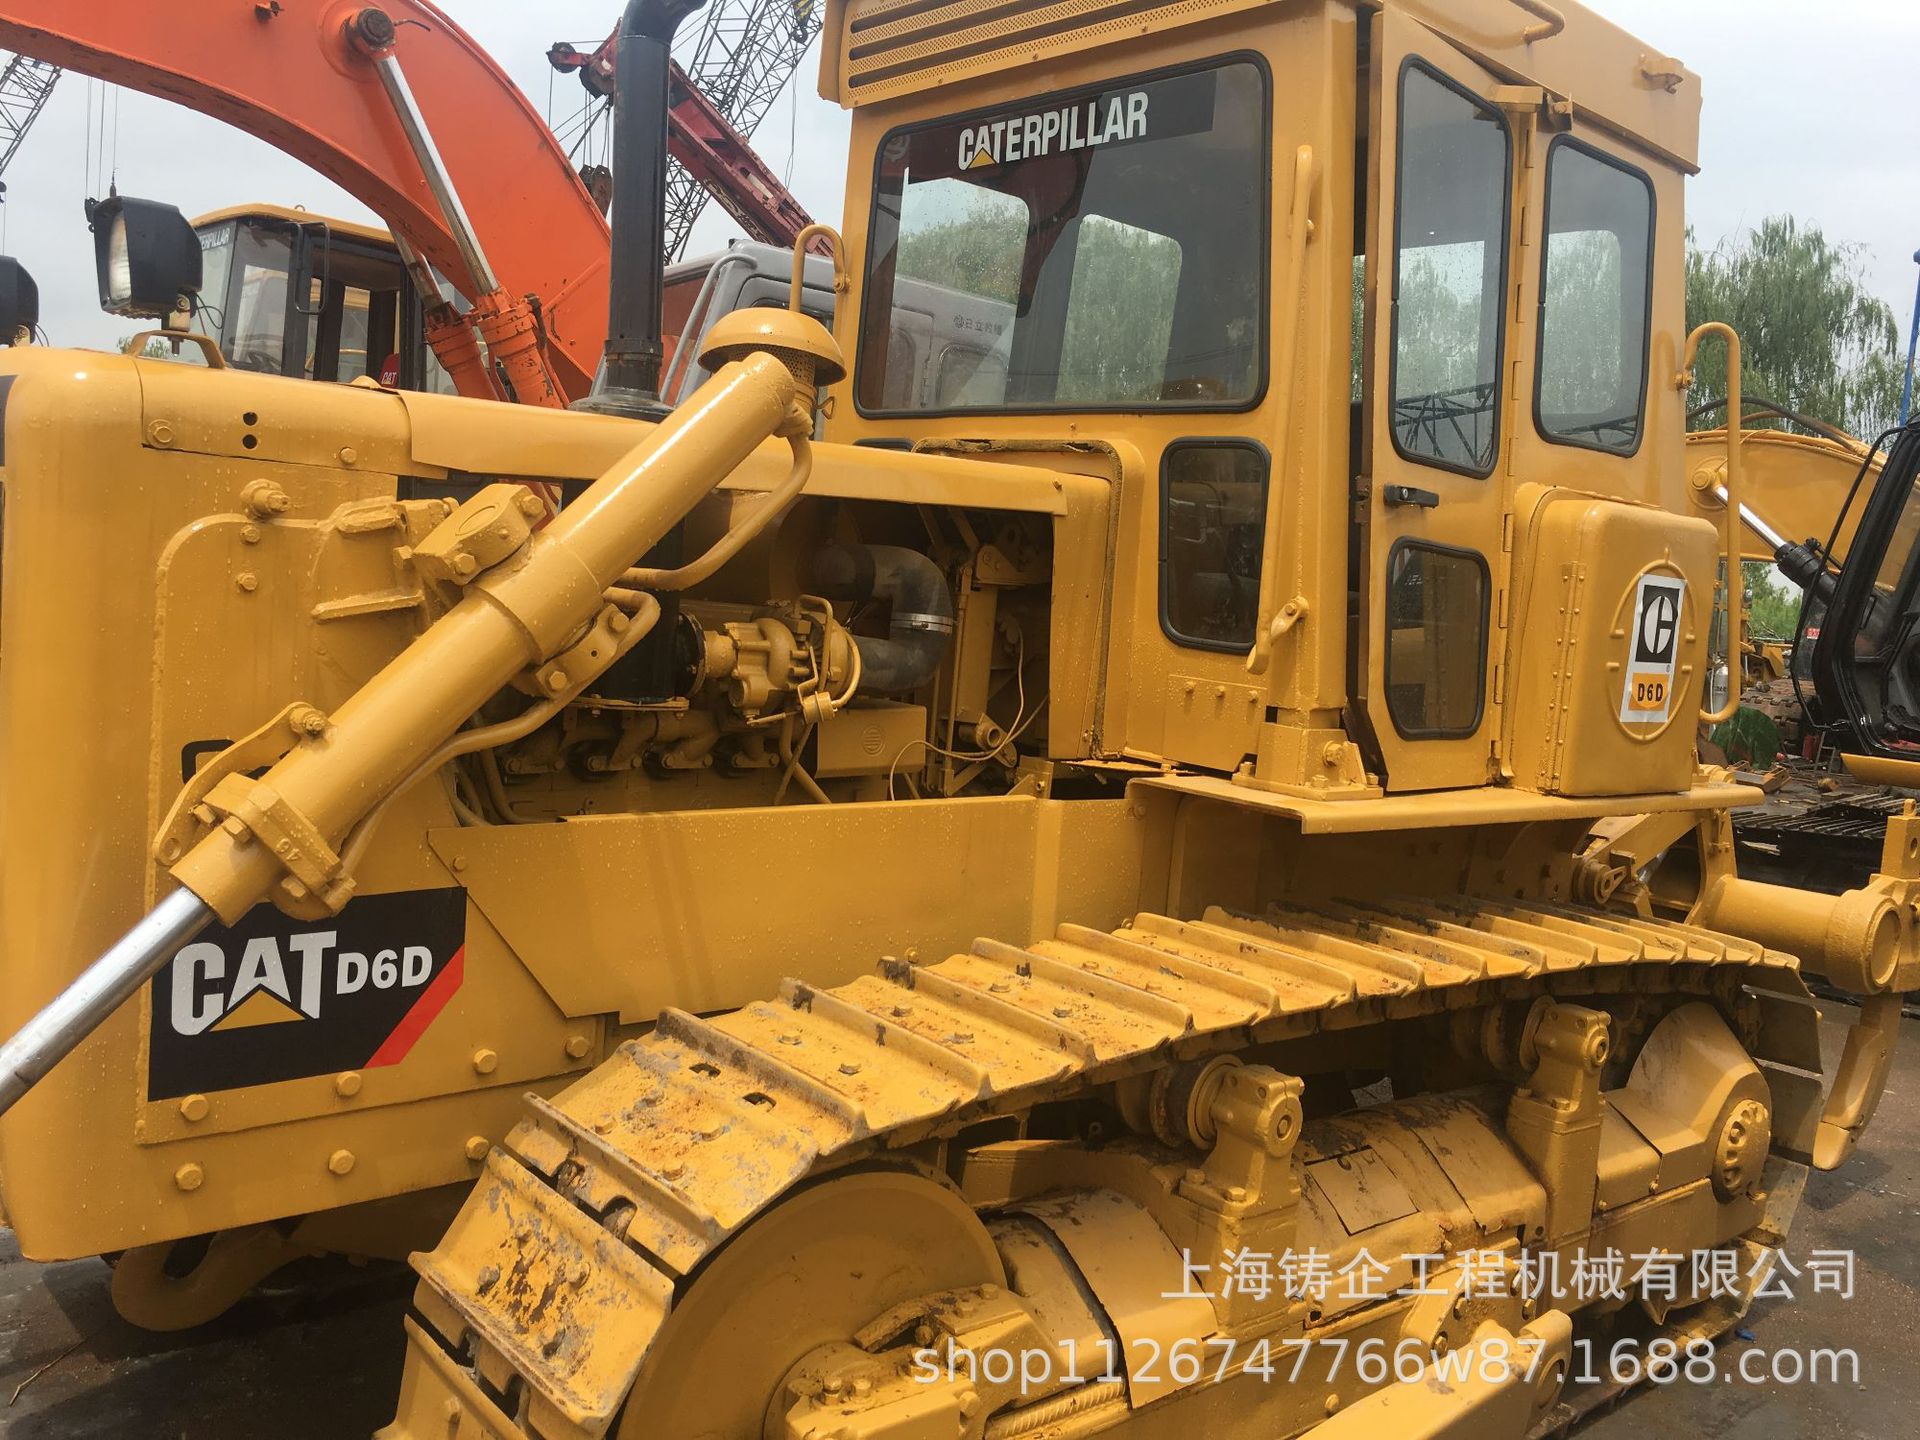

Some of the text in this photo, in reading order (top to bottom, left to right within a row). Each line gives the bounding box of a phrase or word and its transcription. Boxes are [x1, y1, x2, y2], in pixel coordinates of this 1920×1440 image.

[957, 91, 1150, 171] CATERPILLAR
[381, 371, 397, 385] CAT
[1637, 682, 1663, 702] D6D
[171, 930, 433, 1036] CAT D6D
